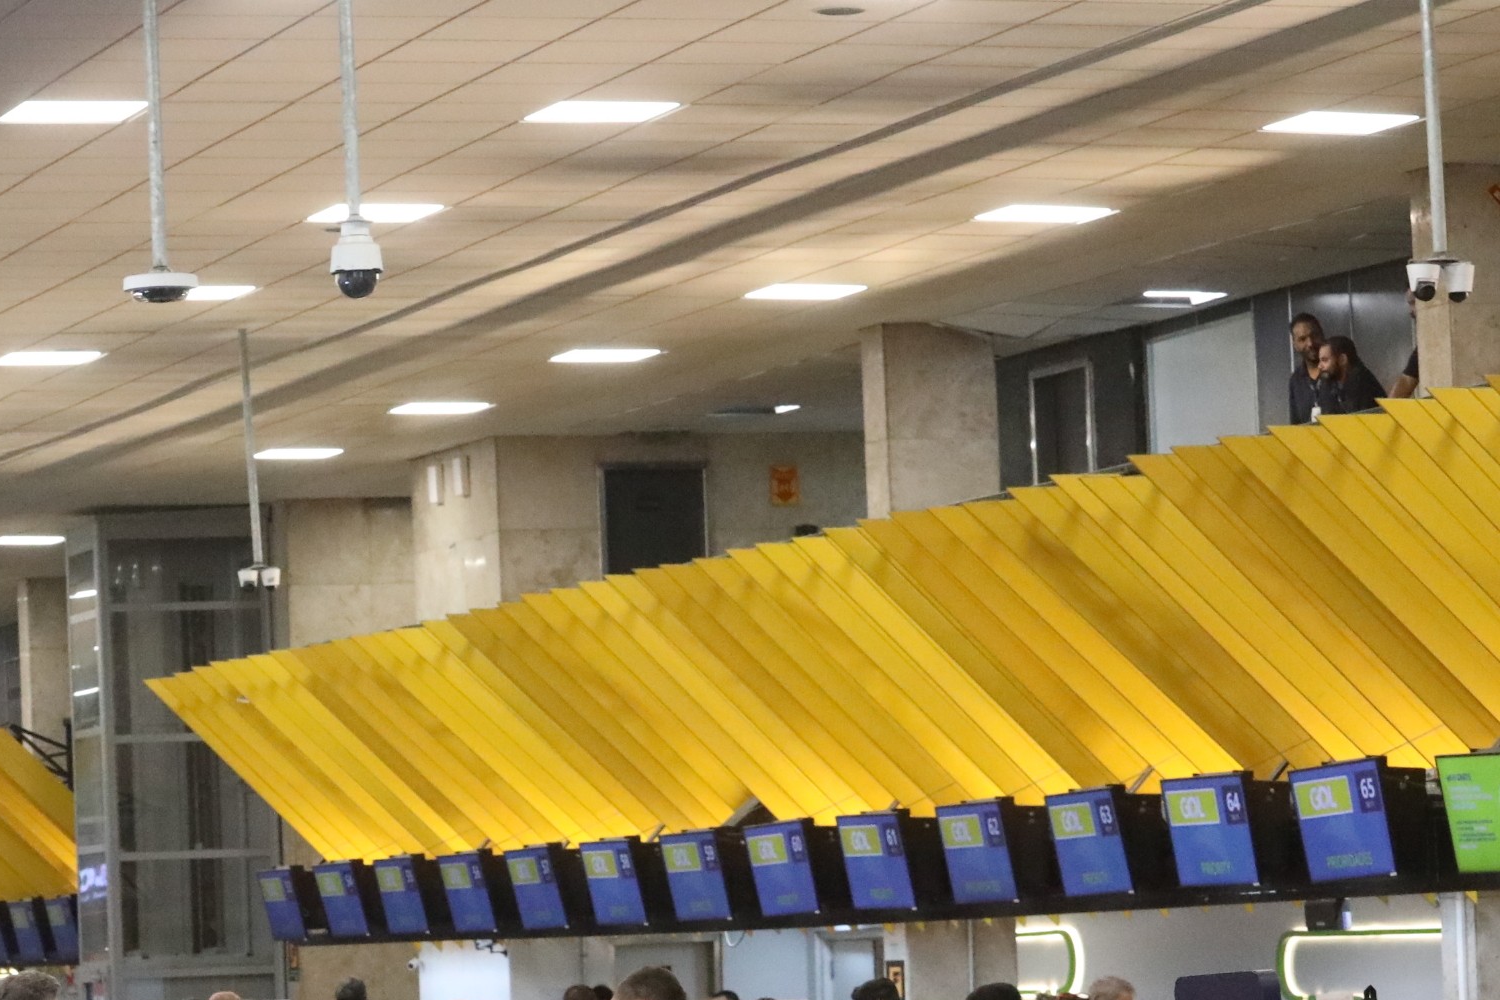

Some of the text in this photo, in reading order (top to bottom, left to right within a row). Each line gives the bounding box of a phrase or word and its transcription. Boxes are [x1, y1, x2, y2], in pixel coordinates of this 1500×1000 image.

[1360, 777, 1376, 799] 65
[1226, 792, 1241, 812] 64
[1309, 785, 1338, 811] GOL
[1099, 805, 1112, 824] 63
[987, 817, 1000, 836] 62
[886, 828, 898, 846] 61
